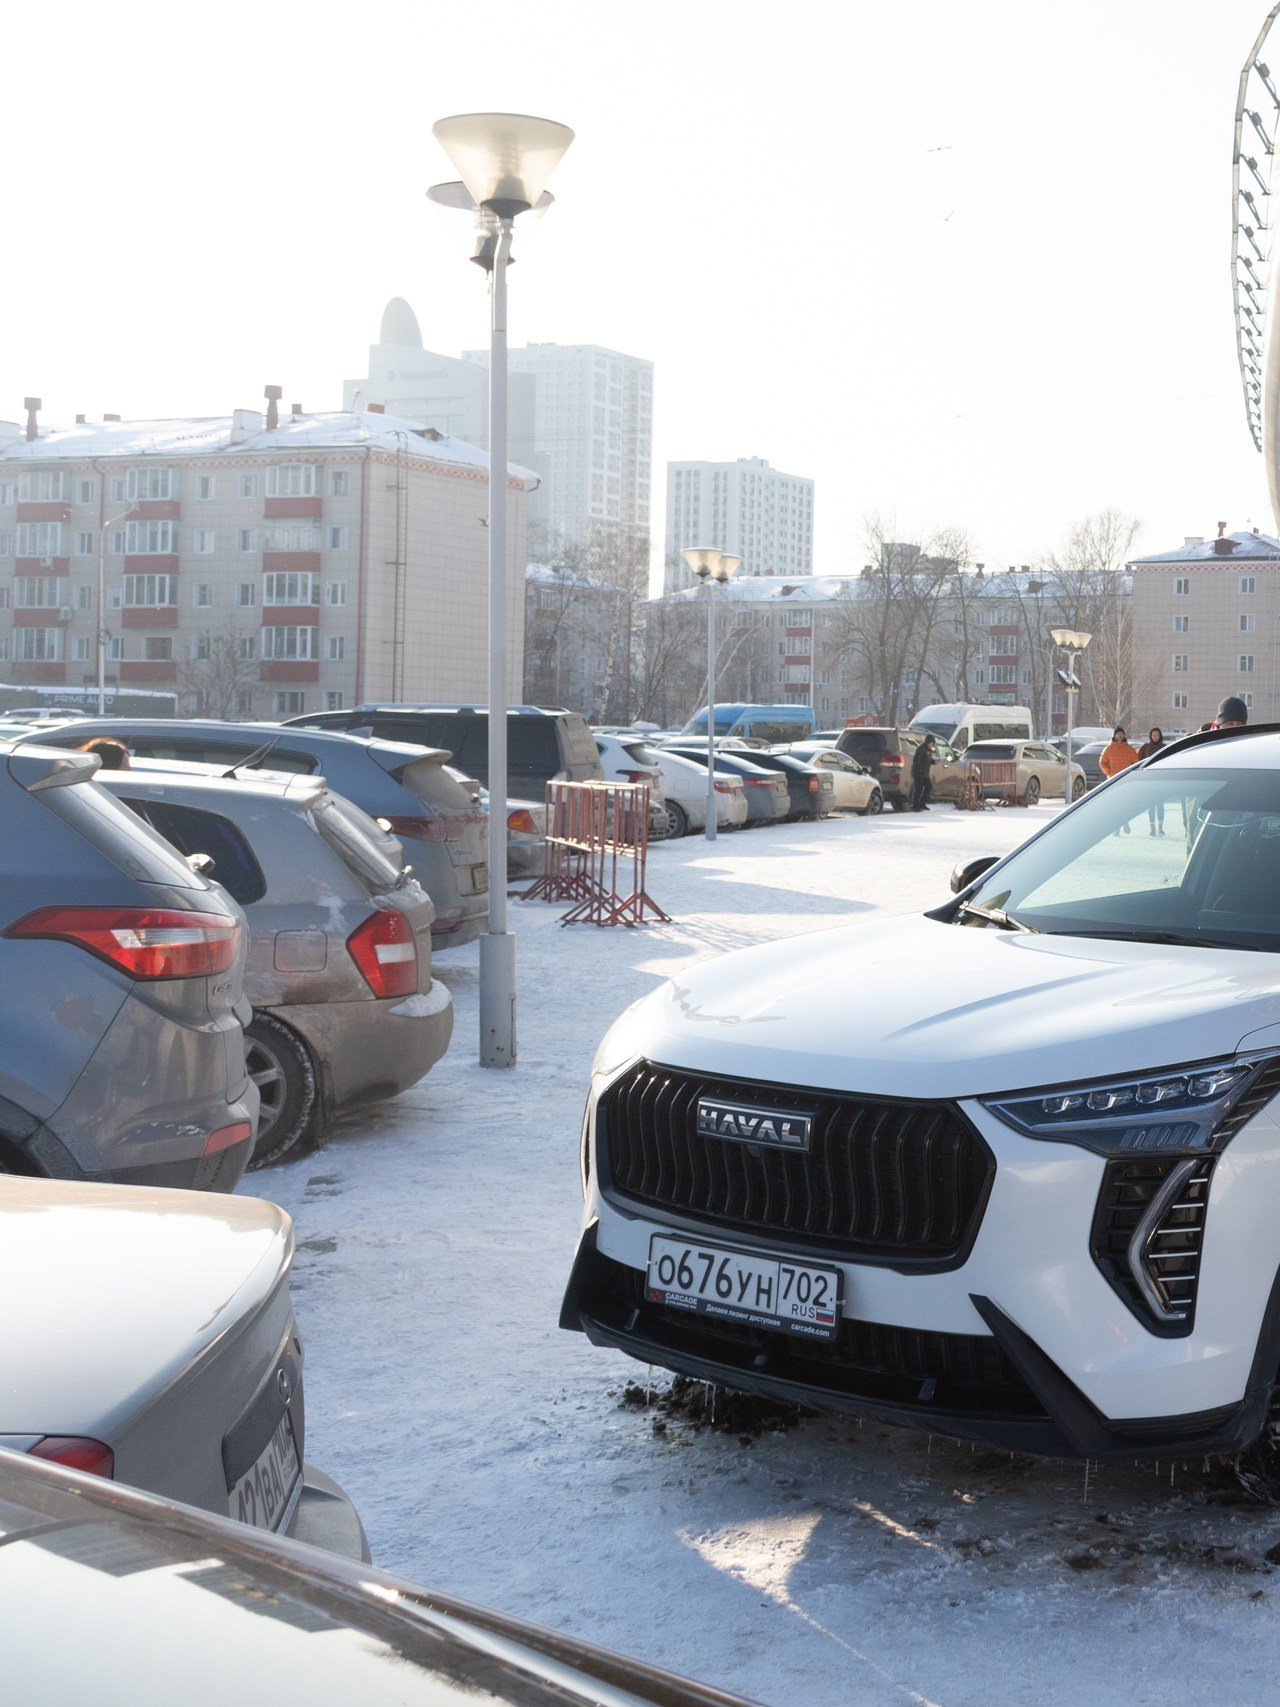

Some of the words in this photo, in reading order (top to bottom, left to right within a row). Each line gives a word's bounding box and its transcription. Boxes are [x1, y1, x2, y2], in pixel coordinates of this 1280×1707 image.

[54, 694, 85, 705] PRIME
[86, 694, 114, 705] AUO
[699, 1108, 802, 1144] HAVAL
[782, 1267, 829, 1308] 702
[665, 1292, 698, 1306] CARCADE
[791, 1303, 816, 1319] RUS
[791, 1323, 830, 1337] carcade.com
